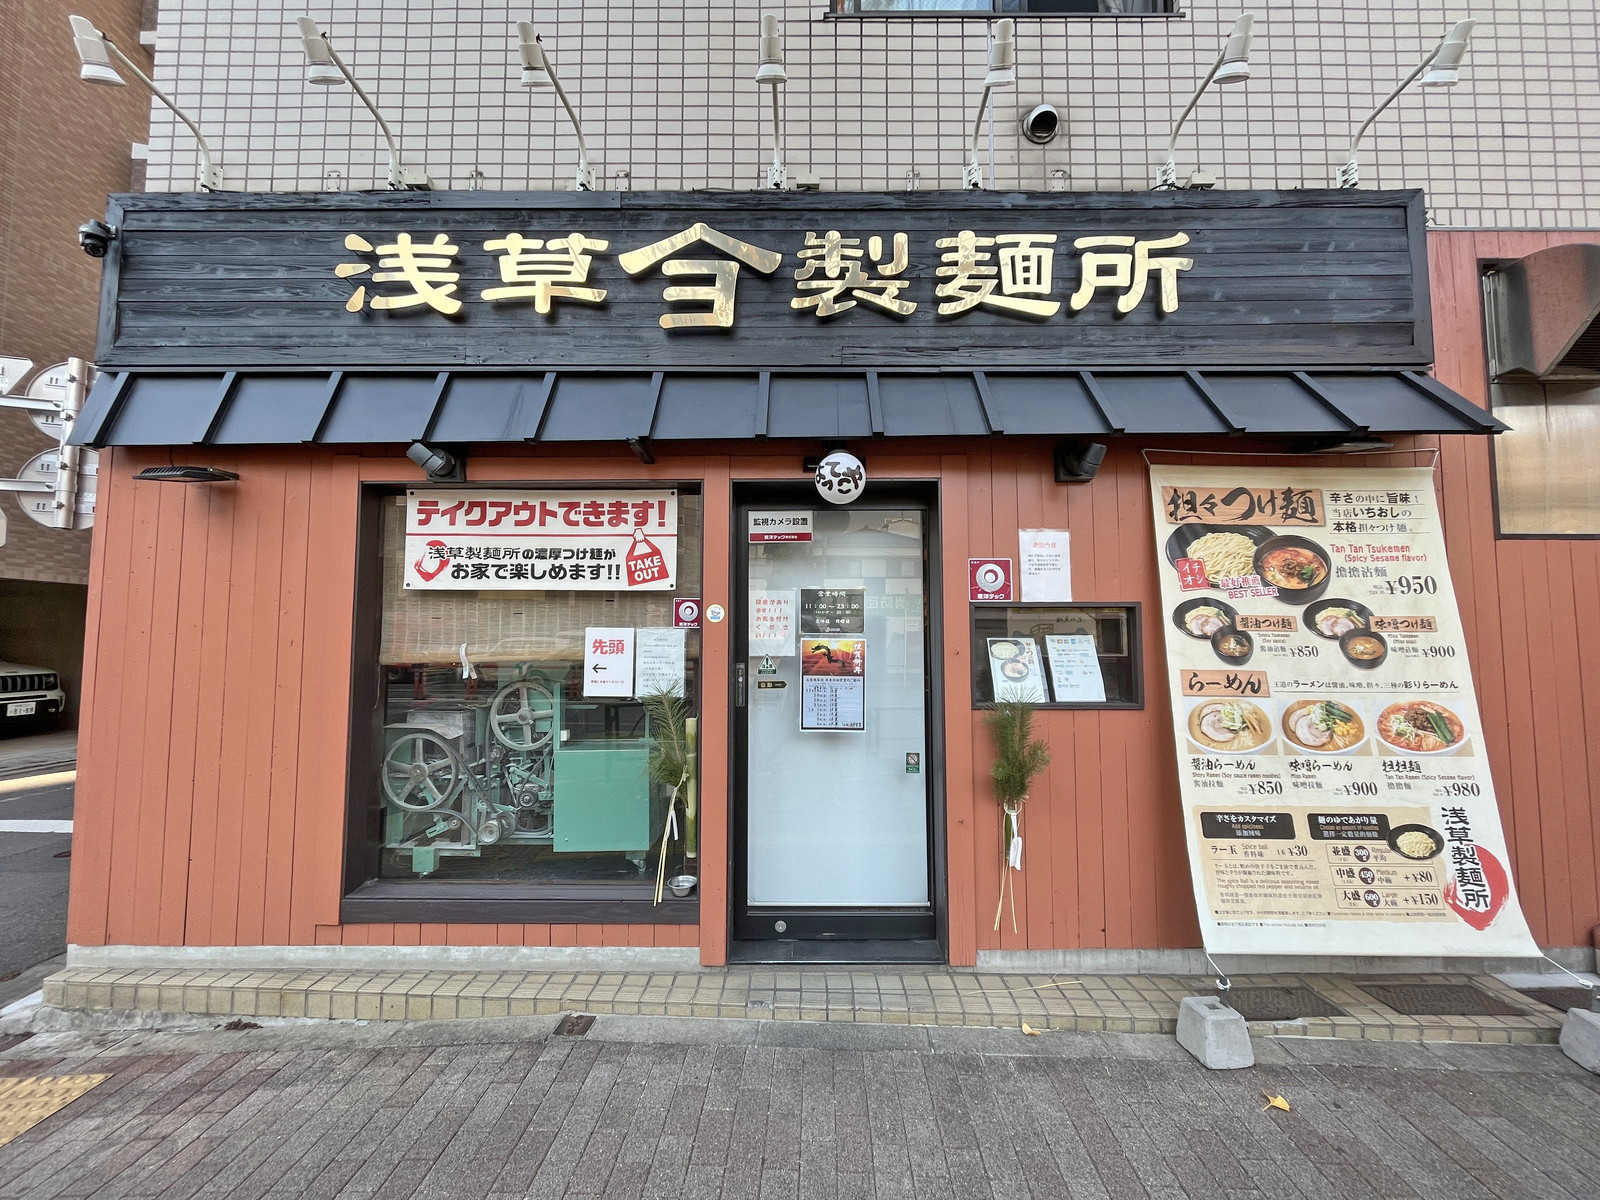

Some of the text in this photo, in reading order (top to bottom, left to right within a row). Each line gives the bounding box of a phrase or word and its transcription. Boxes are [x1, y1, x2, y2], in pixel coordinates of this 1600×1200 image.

[416, 499, 667, 528] テイクアウトできます!
[1332, 506, 1413, 518] 当店いちおしの
[753, 517, 808, 526] 監視カメラ設置
[1329, 544, 1411, 553] Tan Tan Tsukemen
[1344, 553, 1427, 563] (Spicy Sesame flavor)
[628, 557, 662, 572] TAKE
[451, 562, 621, 581] お家で楽しめます!!
[634, 567, 660, 582] OUT
[1385, 575, 1437, 595] ¥950
[1228, 587, 1278, 599] BEST SELLER
[592, 639, 625, 655] 先頭
[1289, 645, 1319, 657] ¥850
[1422, 645, 1456, 658] ¥900
[1188, 671, 1262, 694] らーめん
[1248, 780, 1283, 795] ¥850
[1343, 781, 1378, 796] ¥900
[1443, 782, 1481, 797] ¥980
[1216, 814, 1277, 823] 辛さをカスタマイズ
[1241, 843, 1257, 851] Spice
[1287, 845, 1308, 857] ¥30
[1354, 848, 1369, 856] 300
[1441, 806, 1490, 908] 浅草製麺所
[1359, 870, 1373, 878] 450
[1364, 892, 1379, 901] 600
[1381, 891, 1398, 899] Large
